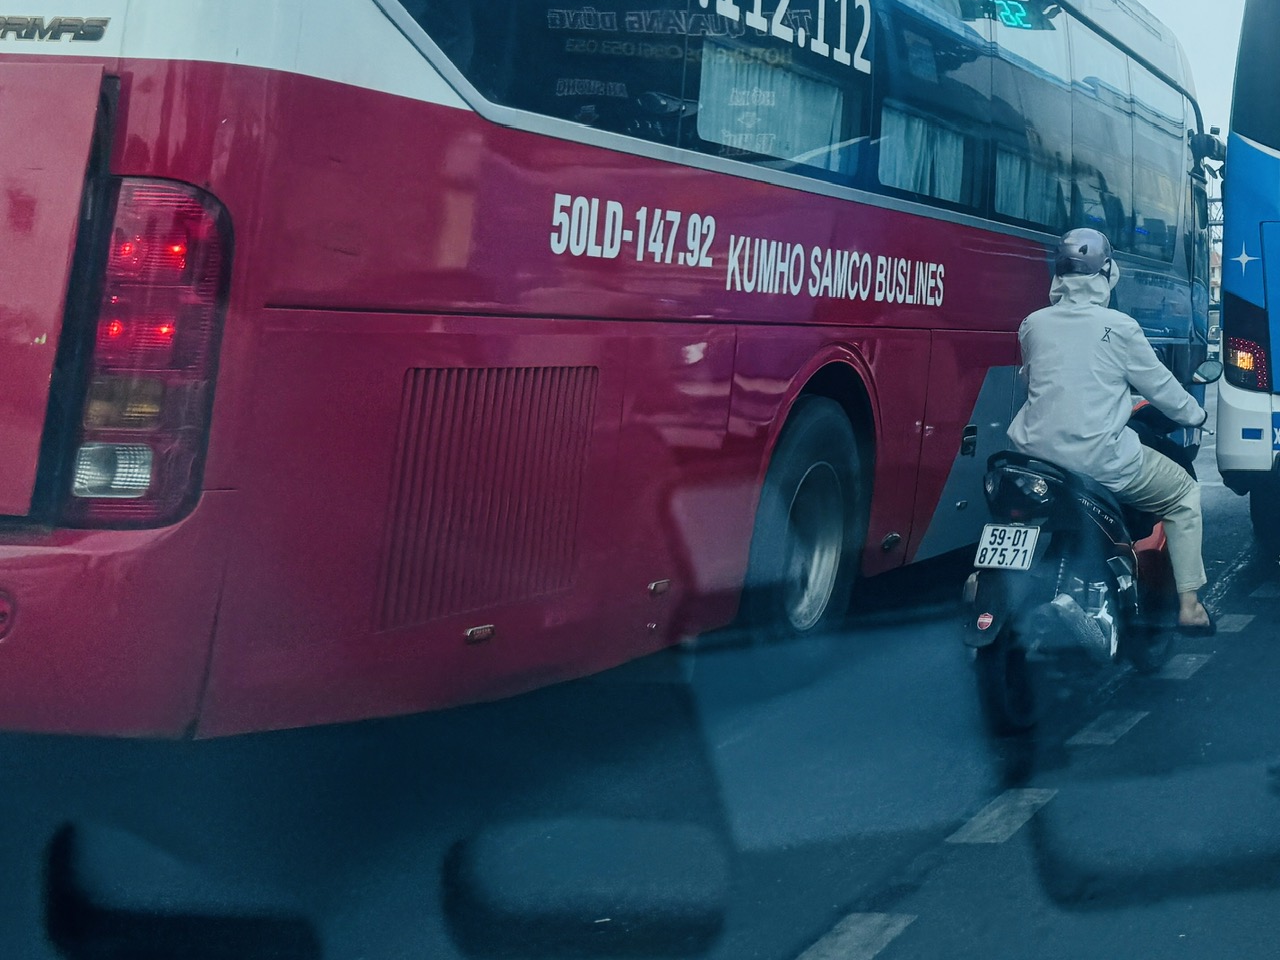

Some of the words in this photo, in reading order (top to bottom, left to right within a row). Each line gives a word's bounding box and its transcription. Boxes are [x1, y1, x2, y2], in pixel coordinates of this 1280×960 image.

[550, 193, 716, 268] 50LD-147.92
[726, 234, 805, 296] KUMHO
[808, 245, 871, 301] SAMCO
[875, 255, 945, 307] BUSLINES
[989, 528, 1029, 547] 59-D1
[978, 547, 1028, 567] 875.71
